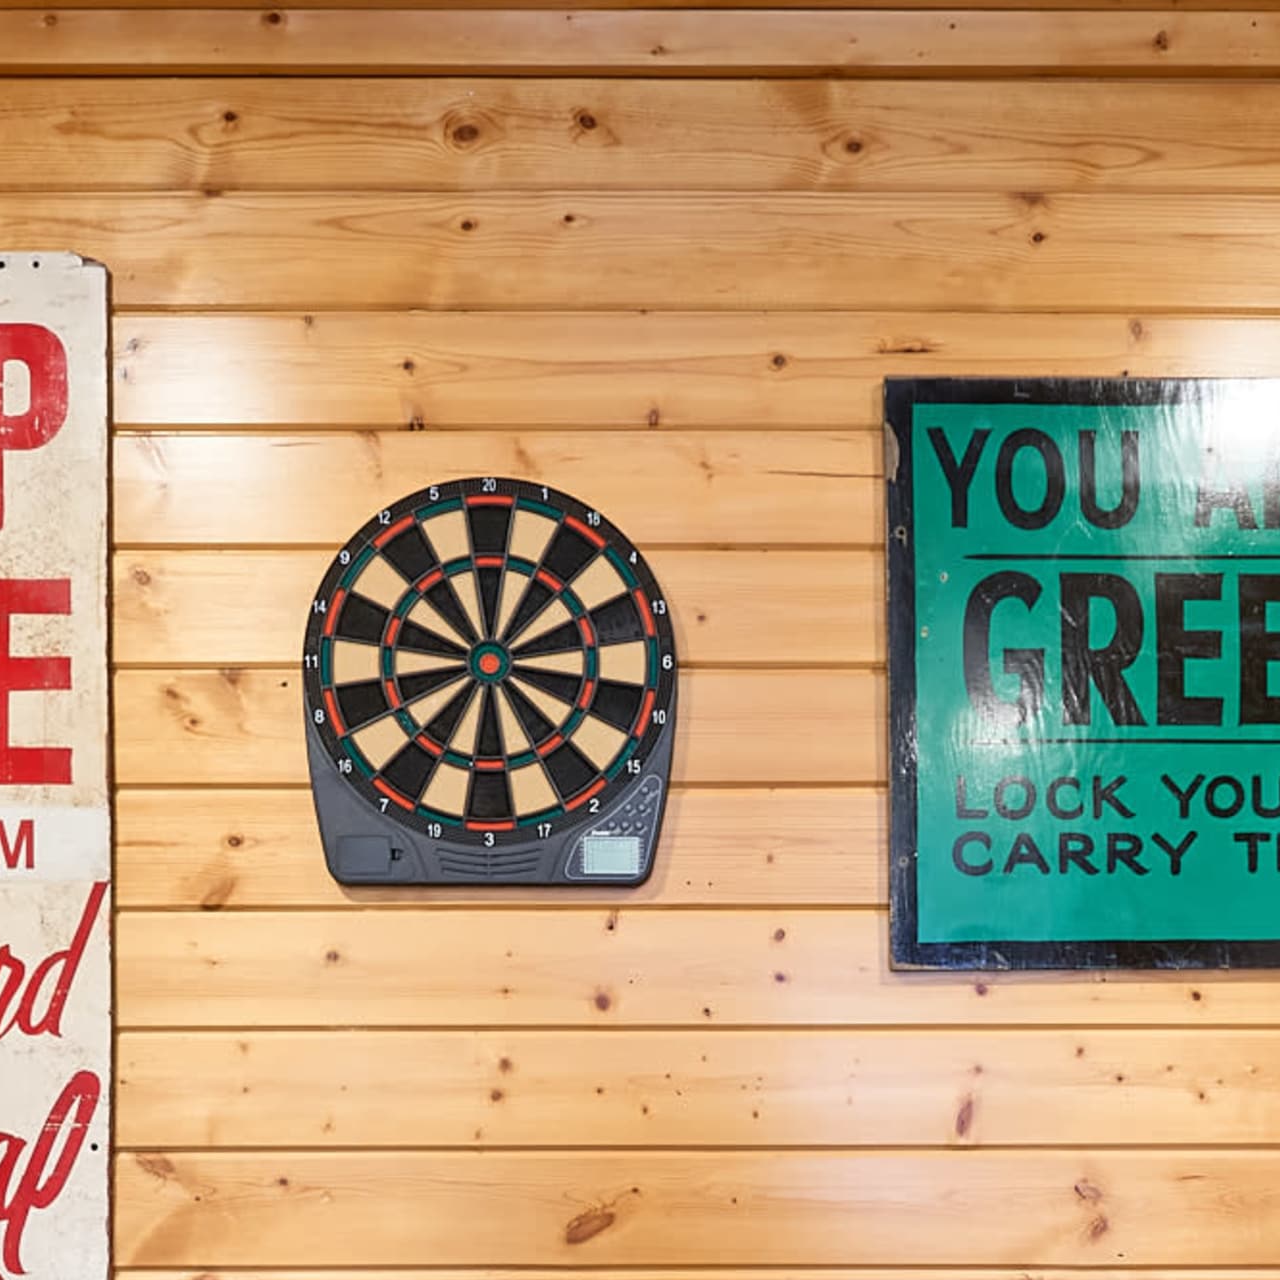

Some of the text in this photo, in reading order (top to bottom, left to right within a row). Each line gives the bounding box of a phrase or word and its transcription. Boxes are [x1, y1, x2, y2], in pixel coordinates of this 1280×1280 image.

[482, 479, 496, 491] 20
[927, 427, 1139, 530] YOU
[430, 488, 439, 500] 5
[542, 488, 548, 500] 1
[378, 511, 391, 524] 12
[340, 551, 350, 564] 9
[629, 551, 637, 564] 4
[313, 600, 326, 612] 14
[652, 600, 666, 614] 13
[304, 656, 318, 669] 11
[662, 655, 672, 668] 6
[314, 710, 324, 723] 8
[653, 711, 666, 724] 10
[338, 760, 352, 773] 16
[627, 760, 641, 773] 15
[955, 775, 1136, 820] LOCK
[380, 799, 389, 812] 7
[589, 799, 599, 813] 2
[427, 824, 441, 838] 19
[537, 824, 552, 838] 17
[485, 833, 494, 846] 3
[952, 831, 1198, 876] CARRY
